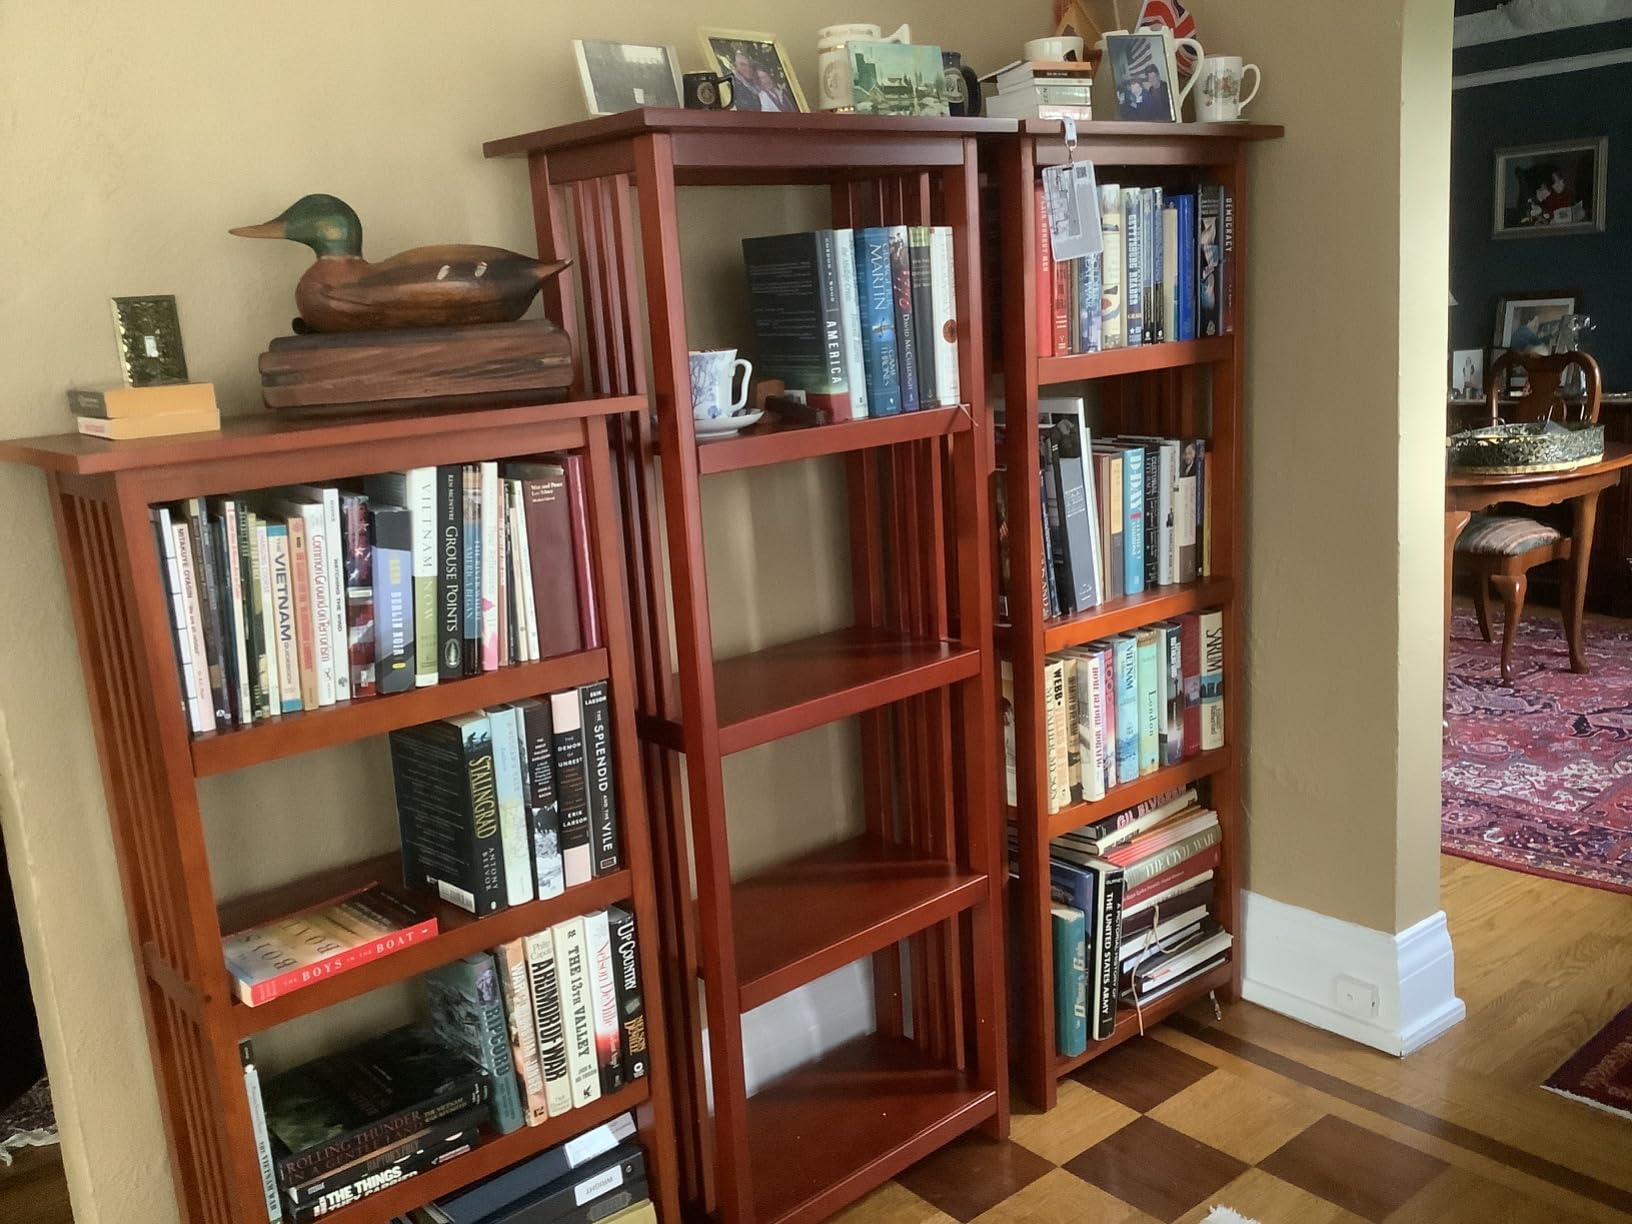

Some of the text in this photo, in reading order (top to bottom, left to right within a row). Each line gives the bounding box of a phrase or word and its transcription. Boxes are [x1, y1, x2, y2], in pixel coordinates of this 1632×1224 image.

[869, 243, 885, 309] MARTIN
[1128, 214, 1137, 304] GETTYSBURG READER
[902, 313, 911, 336] DAVID
[825, 320, 841, 383] AMERICA
[1129, 454, 1141, 510] D-DAY
[176, 527, 188, 565] MITAKUYE
[182, 569, 193, 598] OYASIN
[310, 534, 325, 574] Common
[272, 553, 293, 640] VIETNAM
[314, 574, 328, 608] Ground
[332, 558, 340, 594] WATCHING
[445, 526, 458, 632] GROUSE POINTS
[391, 592, 402, 628] BERLIN
[423, 581, 433, 620] NOW
[317, 621, 332, 662] Terrorism
[392, 632, 404, 655] NOIR
[1206, 627, 1222, 672] SARUM
[1053, 668, 1063, 700] WEBB
[1124, 645, 1134, 689] VIETNAM
[585, 696, 607, 705] LARSON
[590, 690, 602, 698] ERIK
[1147, 690, 1157, 736] London
[1091, 667, 1102, 767] HOME BEFORE MORNING
[557, 742, 581, 752] DEMON
[558, 757, 582, 767] UNREST
[593, 724, 608, 791] SPLENDID
[469, 755, 497, 839] STALINGRAD
[567, 810, 582, 819] ERIK
[562, 817, 587, 828] LARSON
[600, 822, 612, 851] VILE
[1117, 810, 1134, 829] GIL
[1194, 833, 1215, 849] WAR
[482, 850, 490, 891] BEEVOR
[488, 847, 498, 889] ANTONY
[300, 958, 343, 981] BOYS
[374, 930, 416, 953] BOAT
[530, 958, 553, 971] A
[594, 942, 613, 982] Nelson
[616, 920, 639, 990] UP COUNTRY
[1101, 892, 1113, 1014] THE UNITED STATES ARMY
[510, 961, 527, 993] WAR
[567, 945, 590, 1057] THE 13TH VALLEY
[598, 981, 618, 1026] DeMille
[482, 1005, 511, 1077] RIPCORD
[539, 1024, 563, 1044] OF
[541, 1042, 568, 1082] WAR
[284, 1110, 422, 1174] ROLLING THUNDER
[260, 1154, 274, 1190] VIETNAM
[267, 1193, 277, 1210] WAR
[326, 1185, 355, 1205] THE
[353, 1165, 403, 1193] THINGS
